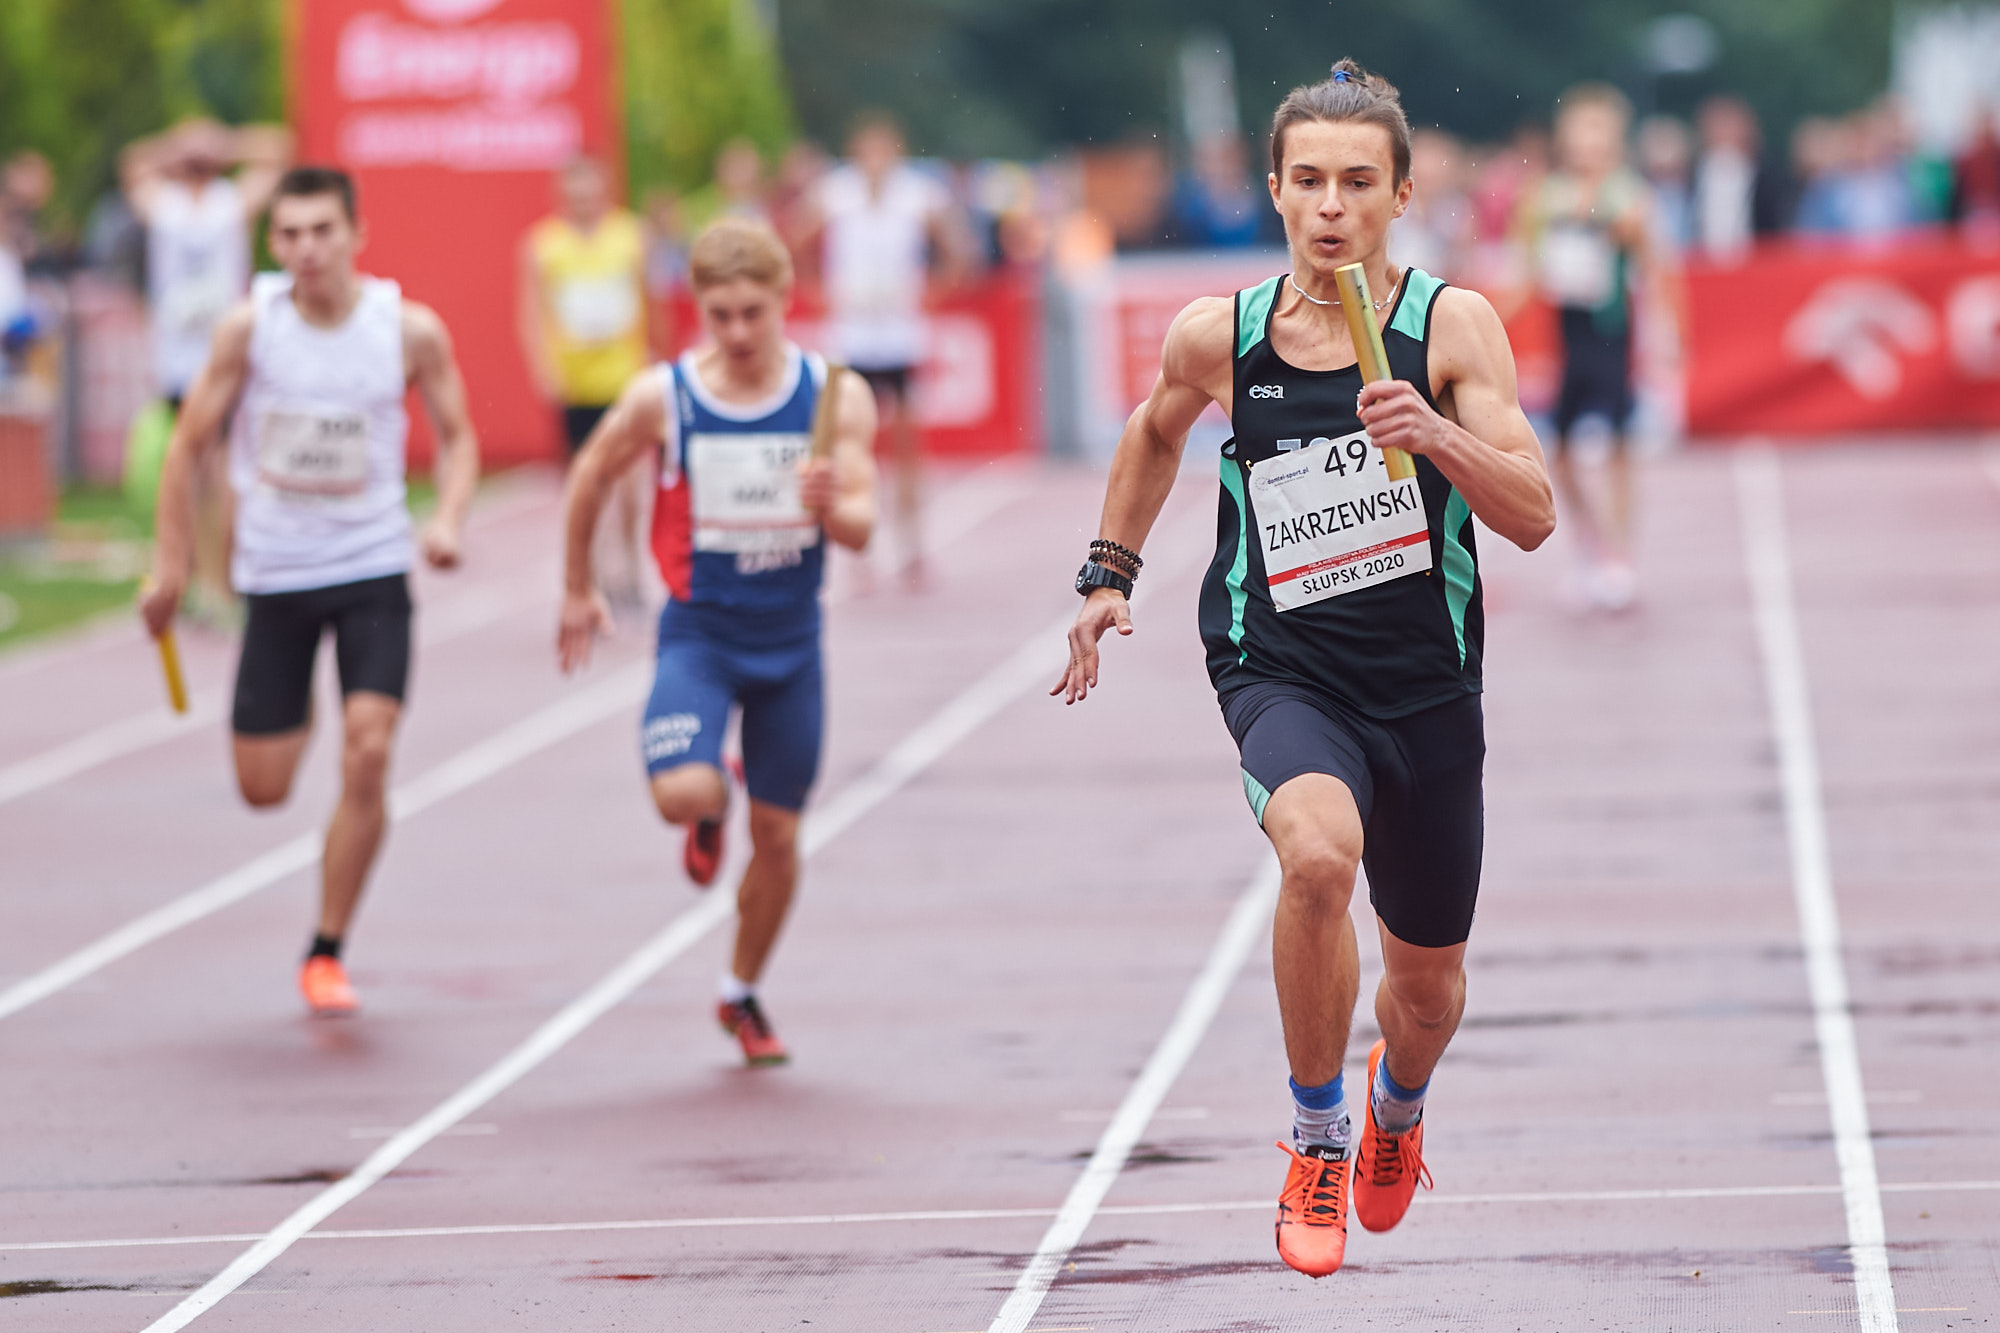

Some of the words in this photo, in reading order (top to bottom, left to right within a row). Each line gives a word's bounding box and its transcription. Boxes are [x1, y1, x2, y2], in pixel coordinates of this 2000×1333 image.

[1249, 384, 1284, 399] esa
[1324, 439, 1385, 477] 49
[1266, 484, 1417, 551] ZAKRZEWSKI
[1302, 566, 1360, 594] SŁUPSK
[1364, 553, 1404, 577] 2020
